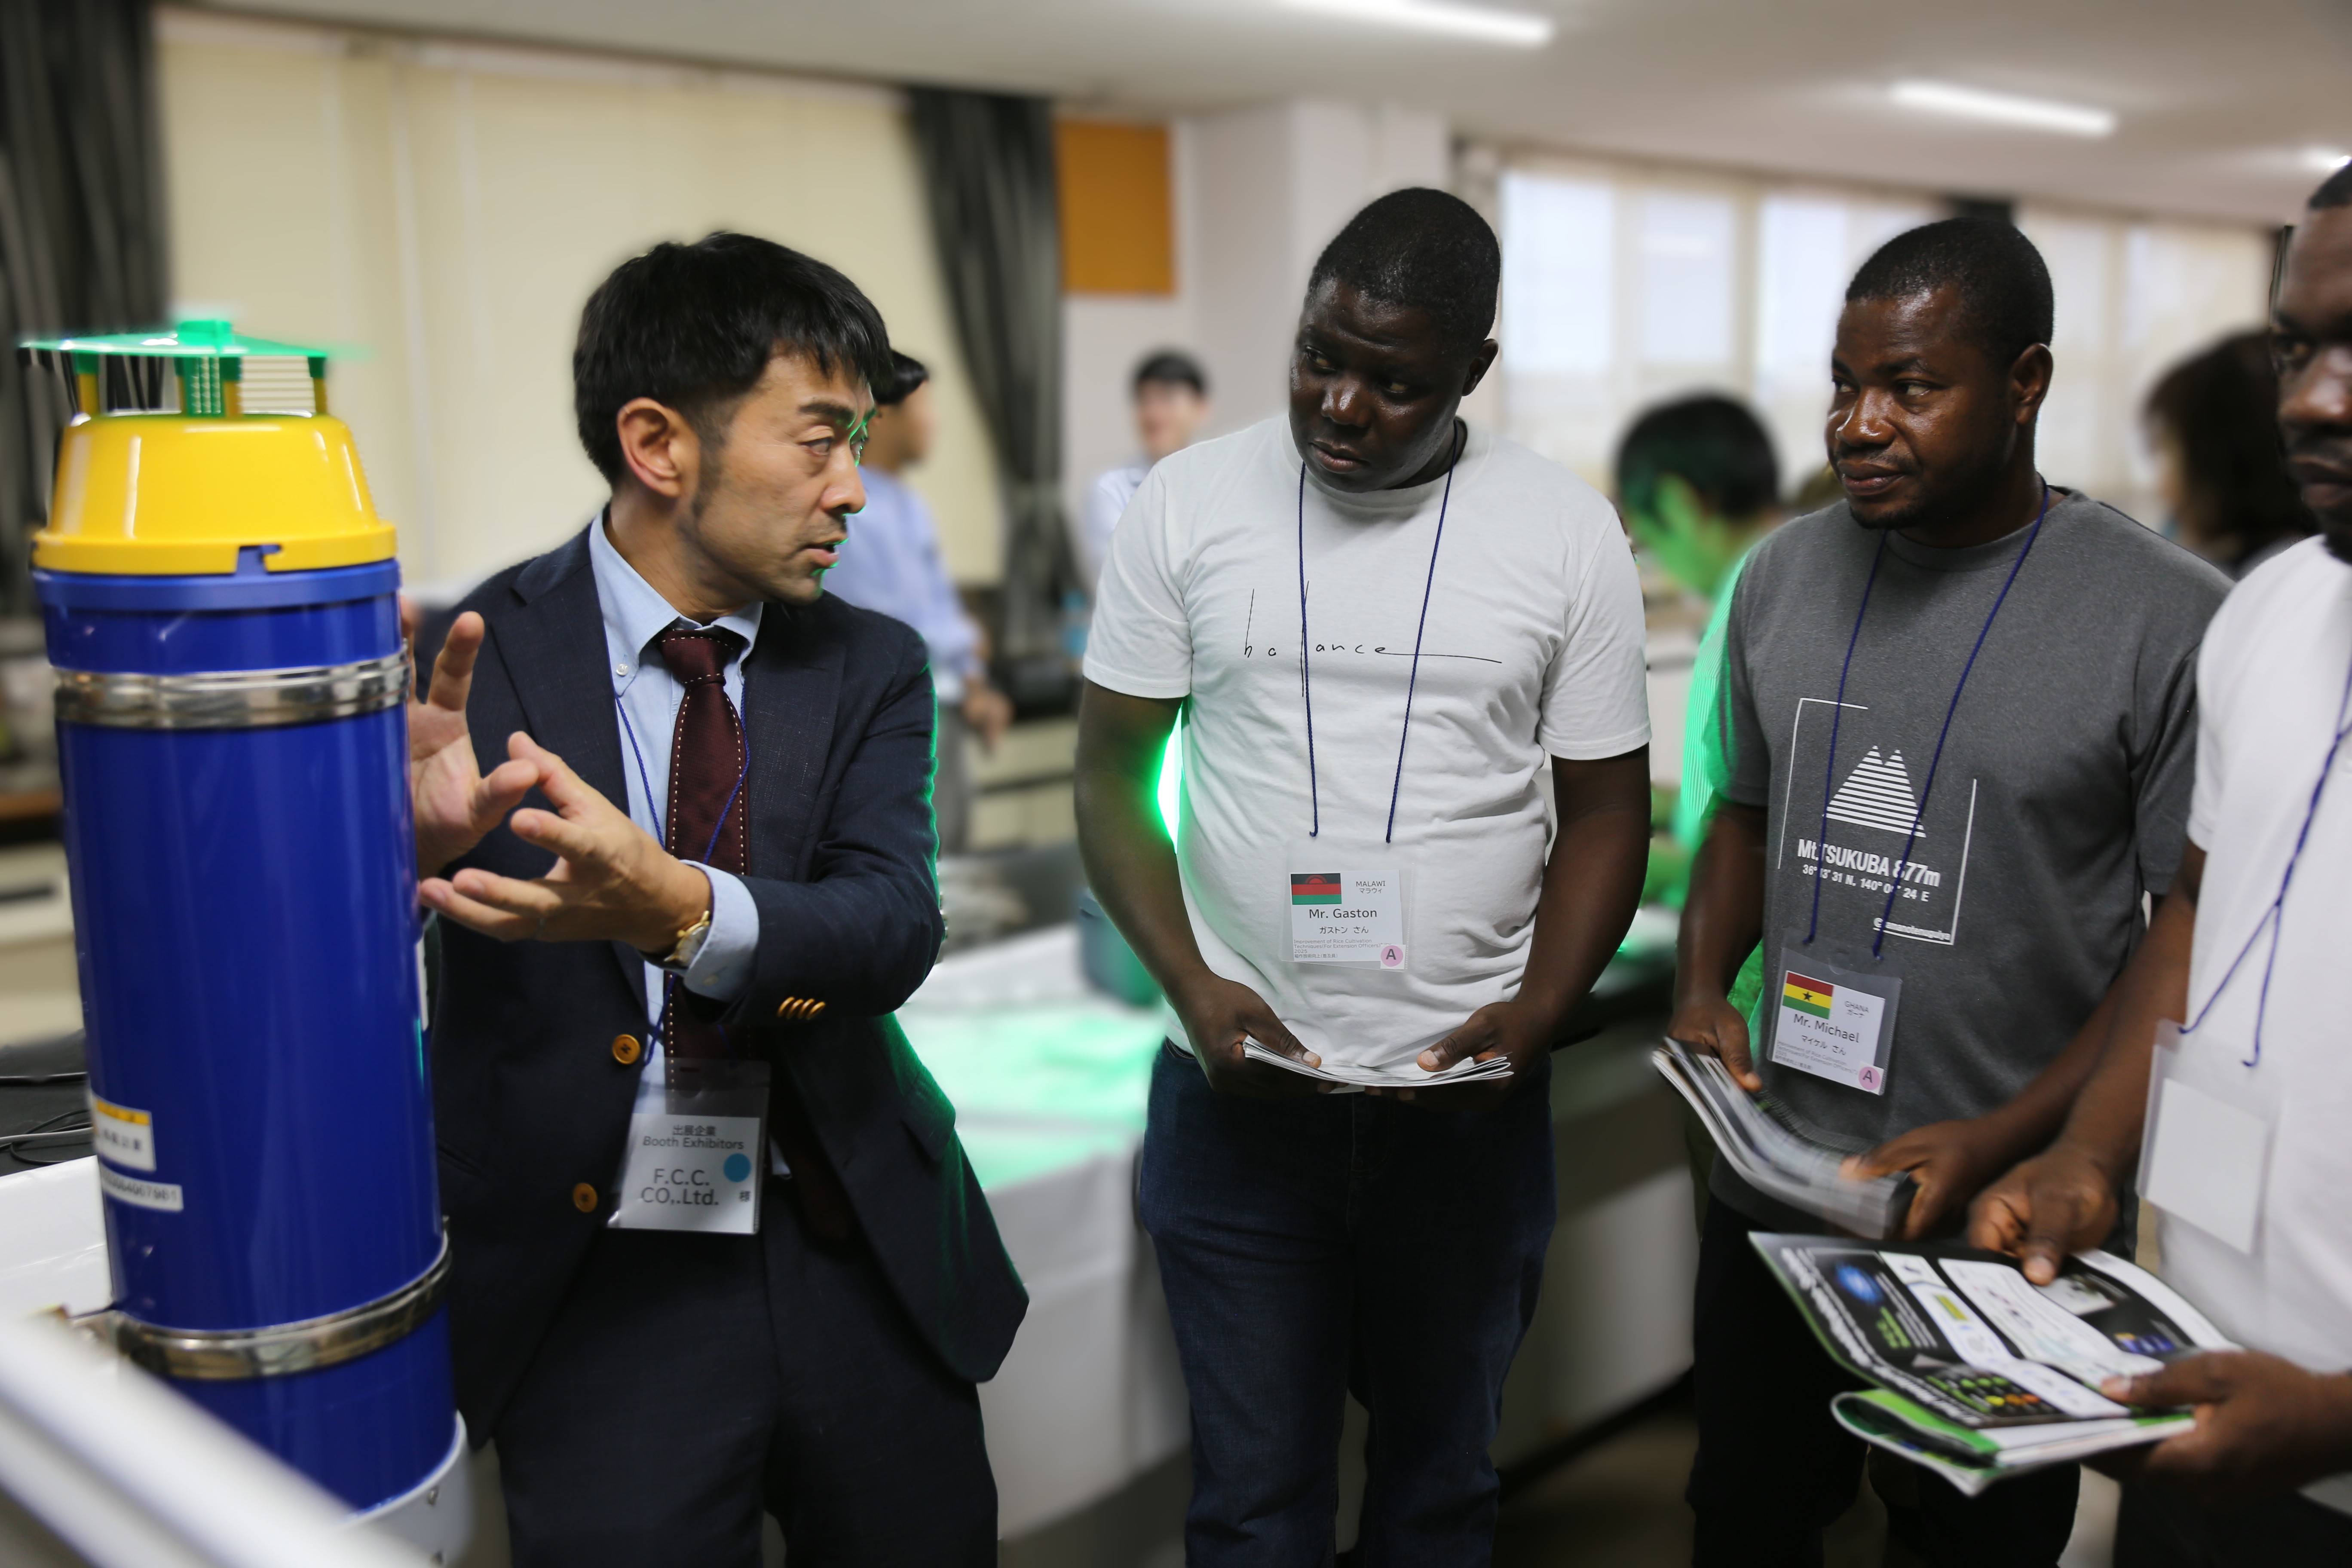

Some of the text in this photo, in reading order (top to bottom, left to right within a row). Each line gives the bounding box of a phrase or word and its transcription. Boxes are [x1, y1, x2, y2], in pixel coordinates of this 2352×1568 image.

[1902, 888, 1917, 900] 24
[1920, 891, 1930, 902] E
[1309, 909, 1377, 919] Mr. Gaston
[1386, 949, 1396, 960] A
[1844, 1001, 1869, 1013] GHANA
[1794, 1014, 1859, 1043] Mr. Michael
[1801, 1035, 1846, 1056] マイケル さん
[1862, 1070, 1873, 1084] A
[673, 1125, 717, 1137] 出展企業
[642, 1136, 744, 1150] Booth Exhibitors
[654, 1168, 710, 1186] F.C.C.
